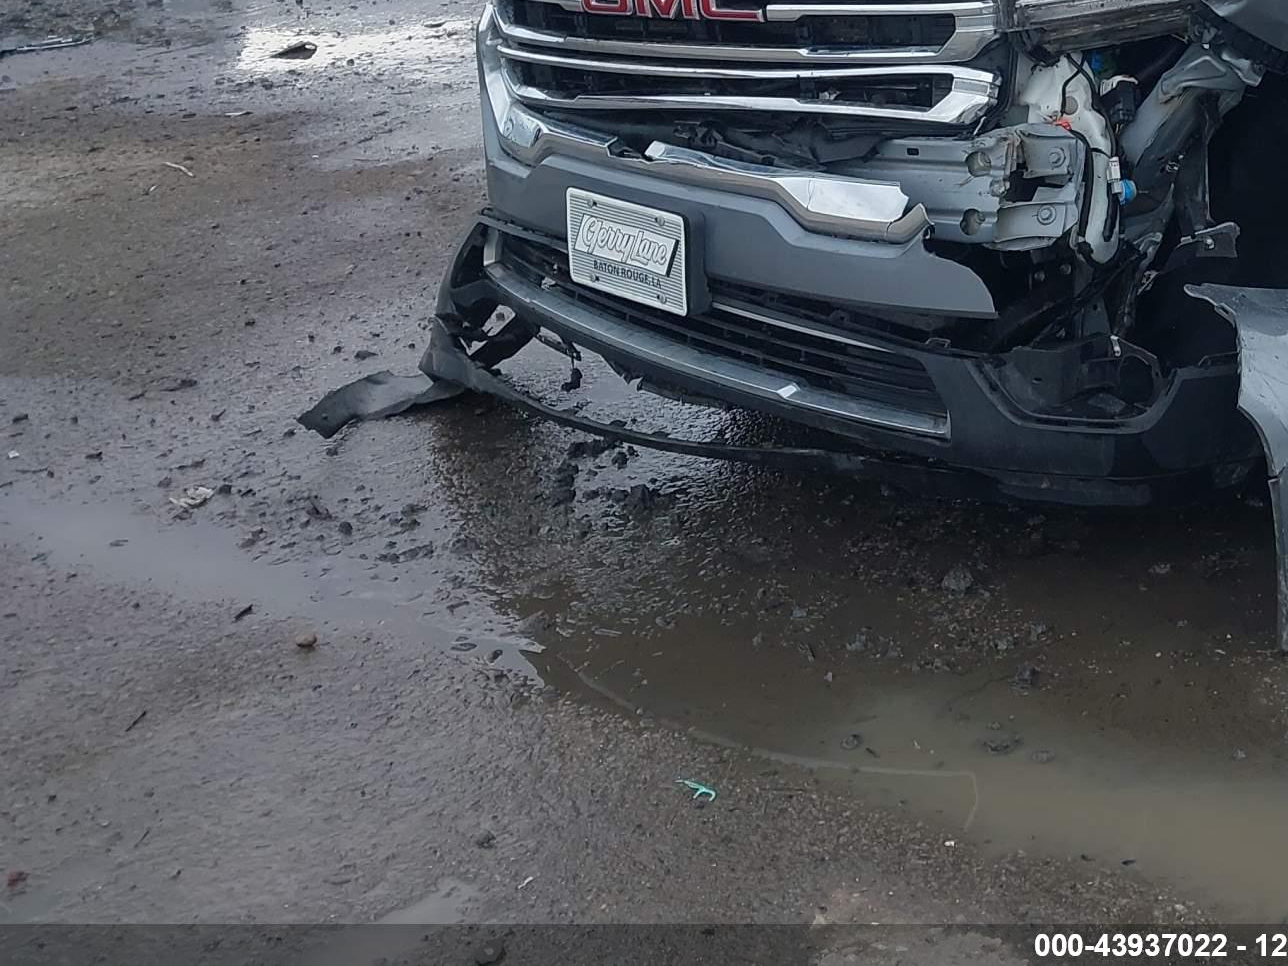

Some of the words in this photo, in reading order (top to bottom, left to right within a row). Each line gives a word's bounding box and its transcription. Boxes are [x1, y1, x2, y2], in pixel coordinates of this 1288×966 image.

[582, 215, 635, 264] Gerry
[630, 229, 668, 266] Lane
[593, 260, 620, 276] BATON
[621, 267, 651, 286] ROUGE,
